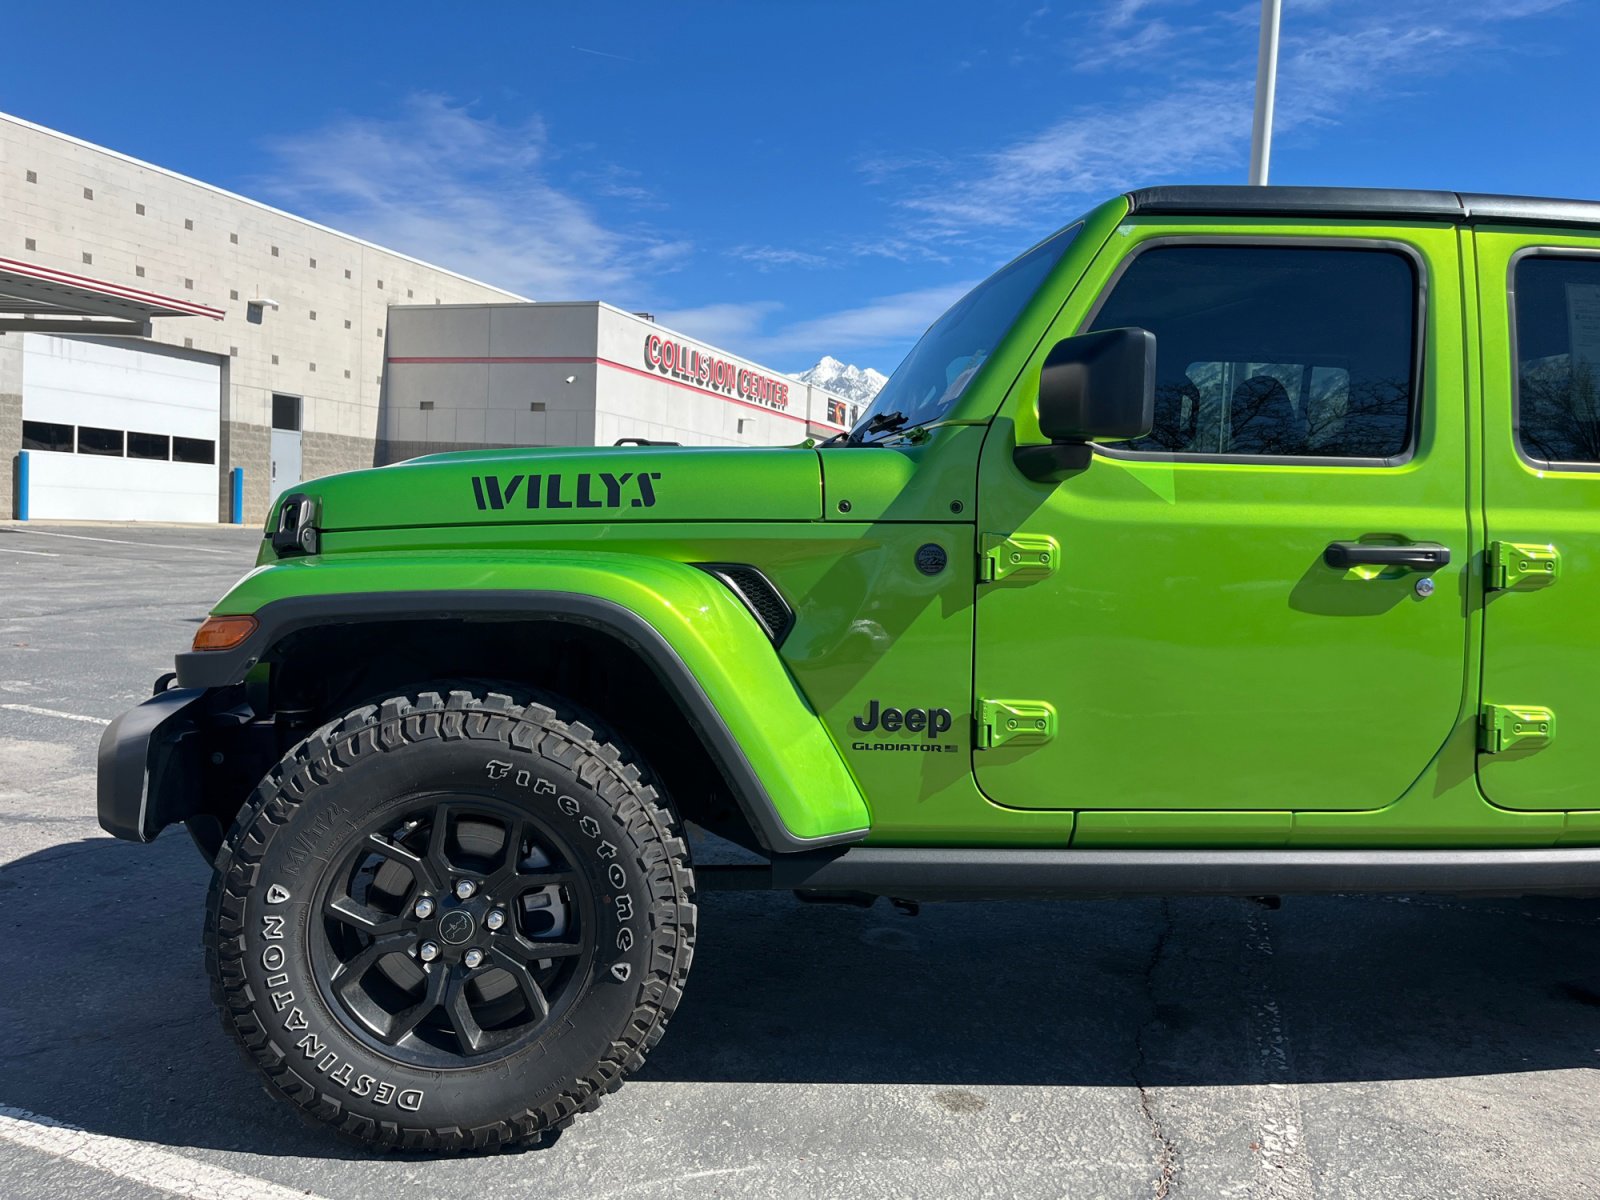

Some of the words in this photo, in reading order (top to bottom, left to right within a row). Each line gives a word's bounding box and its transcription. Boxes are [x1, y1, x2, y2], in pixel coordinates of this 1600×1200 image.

[646, 335, 737, 391] COLLISION
[739, 369, 789, 407] CENTER
[471, 472, 661, 510] WILLYS
[852, 742, 942, 752] GLADIATOR
[853, 700, 952, 739] Jeep
[486, 759, 634, 951] Firestone
[262, 916, 424, 1111] DESTINATION
